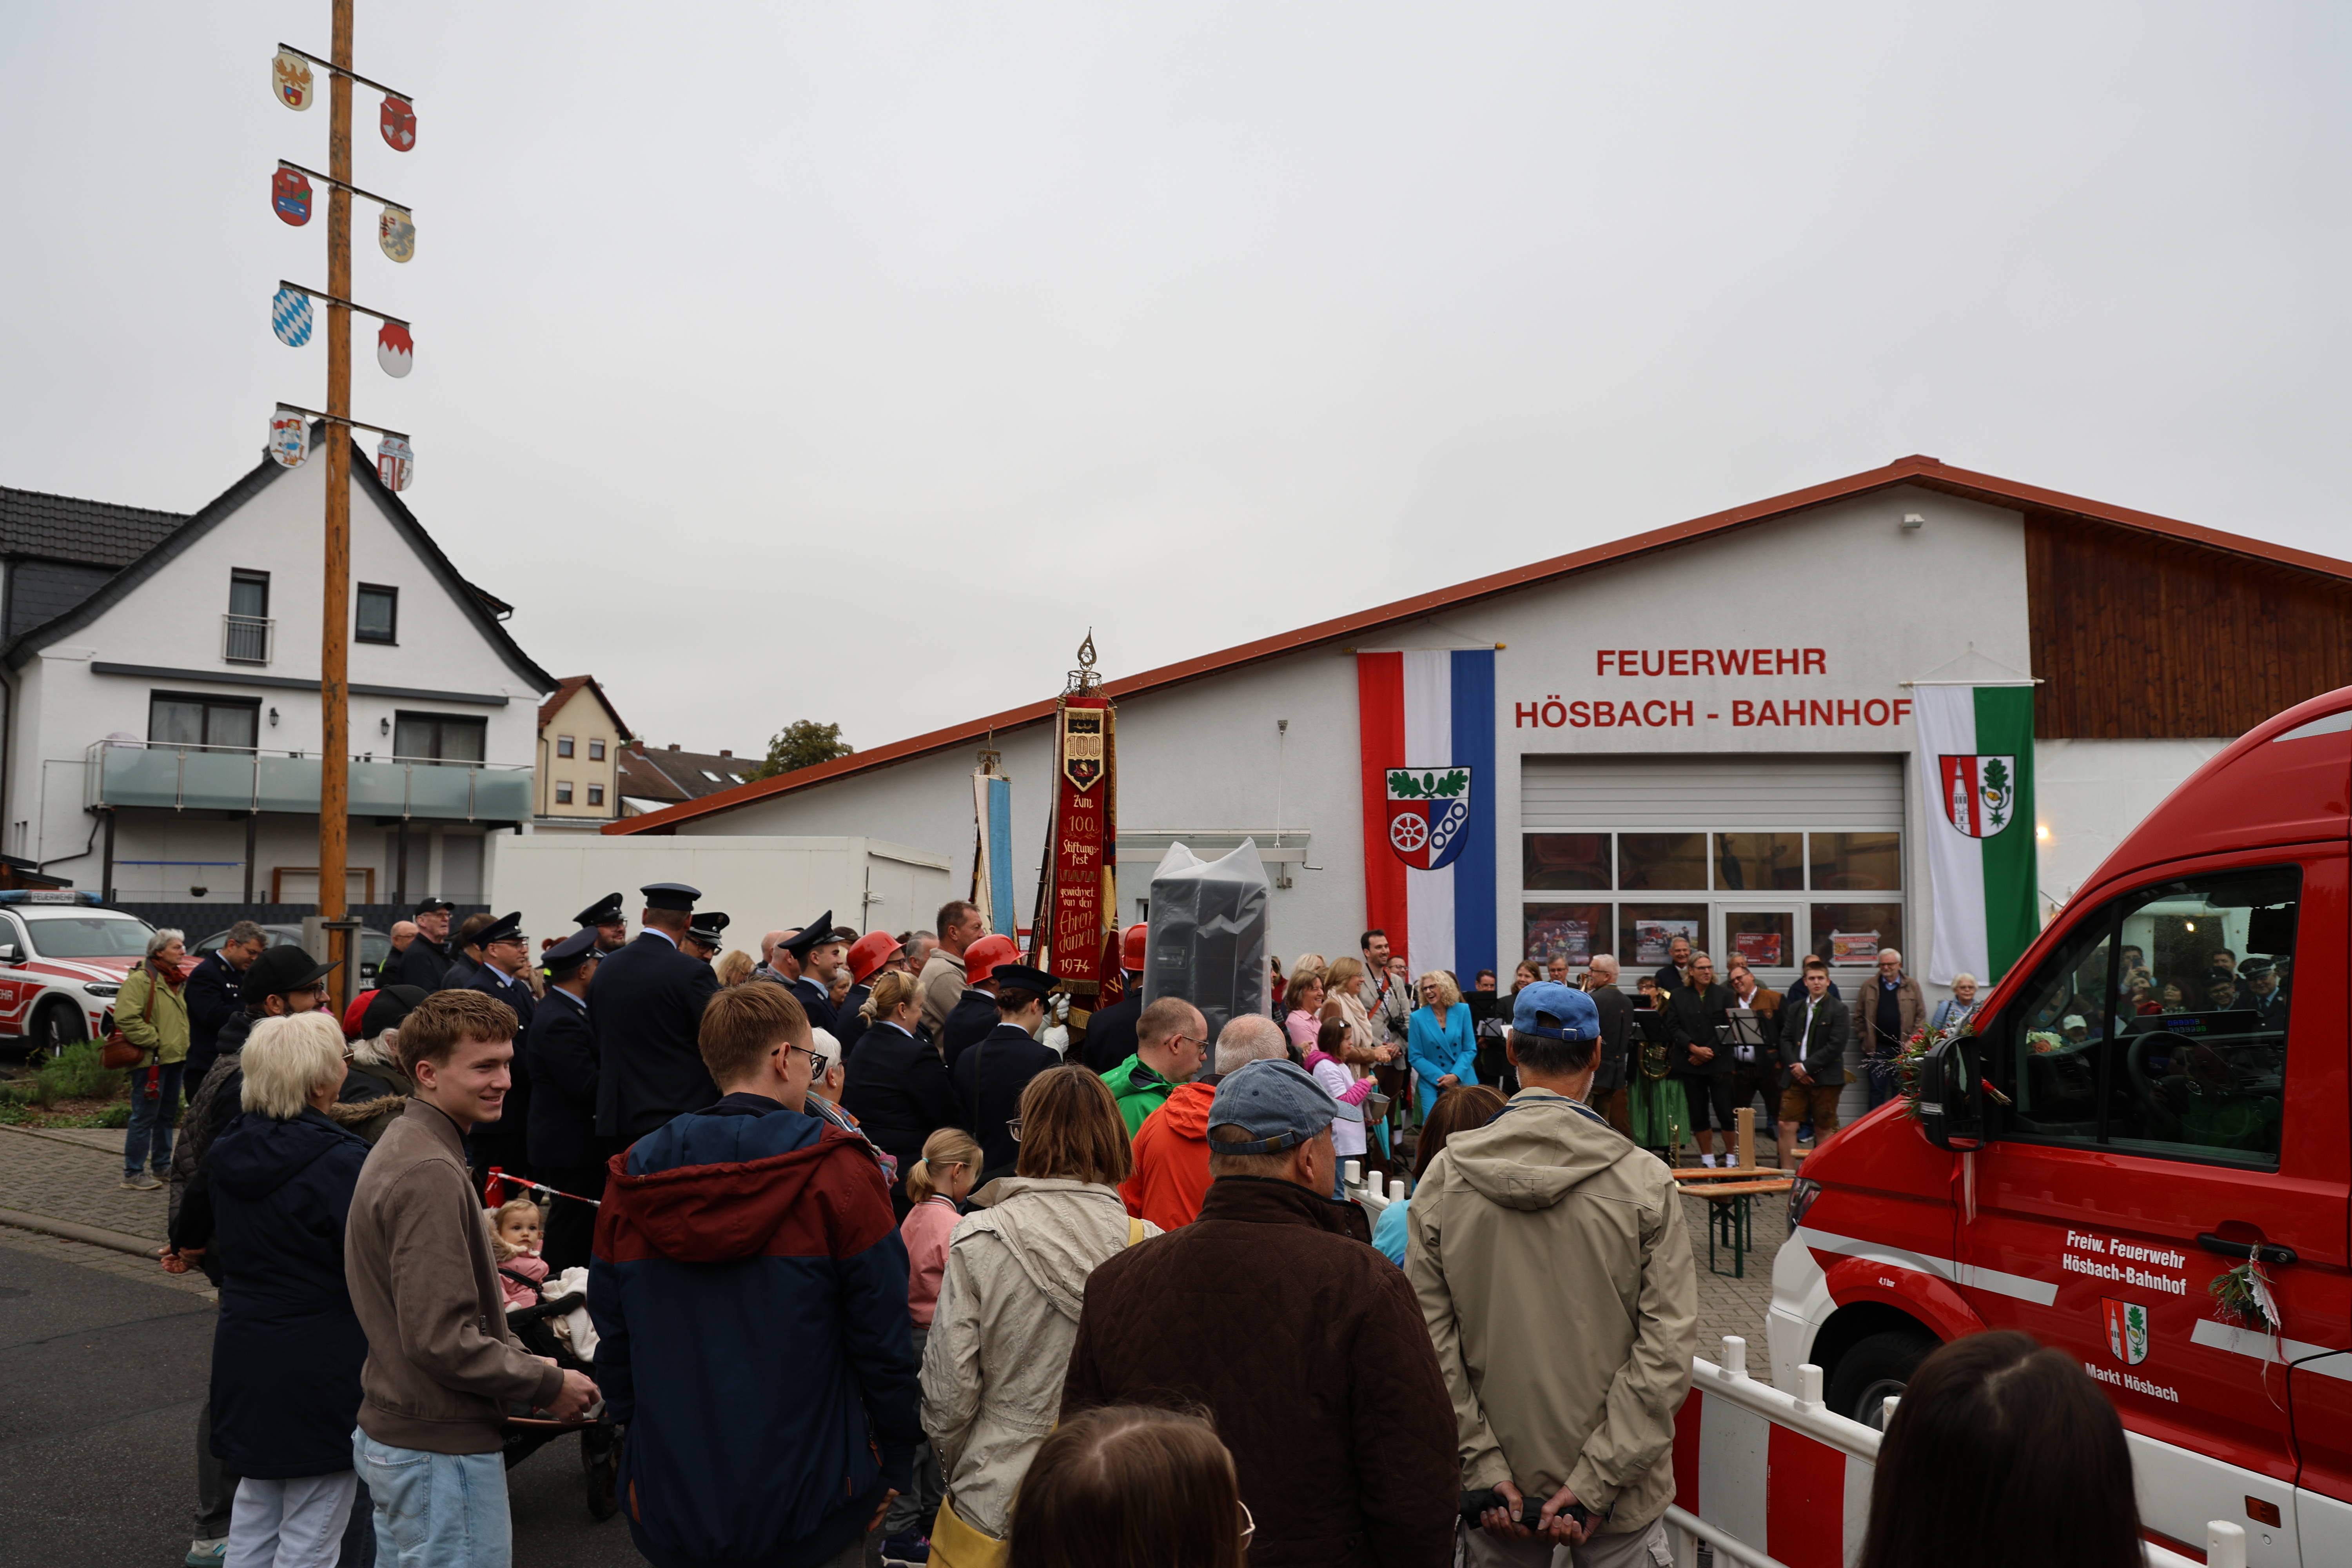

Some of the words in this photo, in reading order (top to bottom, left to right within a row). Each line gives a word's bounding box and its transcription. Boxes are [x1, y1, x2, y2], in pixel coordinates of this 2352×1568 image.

[1597, 648, 1827, 676] FEUERWEHR
[1515, 695, 1693, 728] HÖSBACH
[1732, 699, 1913, 726] BAHNHOF
[1067, 735, 1101, 757] 100
[1073, 794, 1094, 809] Zum
[1069, 815, 1095, 832] 100.
[1062, 839, 1100, 855] Stiftungs-
[1072, 853, 1089, 867] fest
[33, 892, 74, 901] FEUERWEHR
[1079, 897, 1092, 908] den
[1059, 928, 1096, 953] damen
[1060, 958, 1090, 974] 1974
[2066, 1230, 2105, 1253] Freiw.
[2109, 1238, 2186, 1269] Feuerwehr
[2062, 1253, 2187, 1296] Hösbach-Bahnhof
[2085, 1362, 2122, 1386] Markt
[2123, 1373, 2179, 1403] Hösbach
